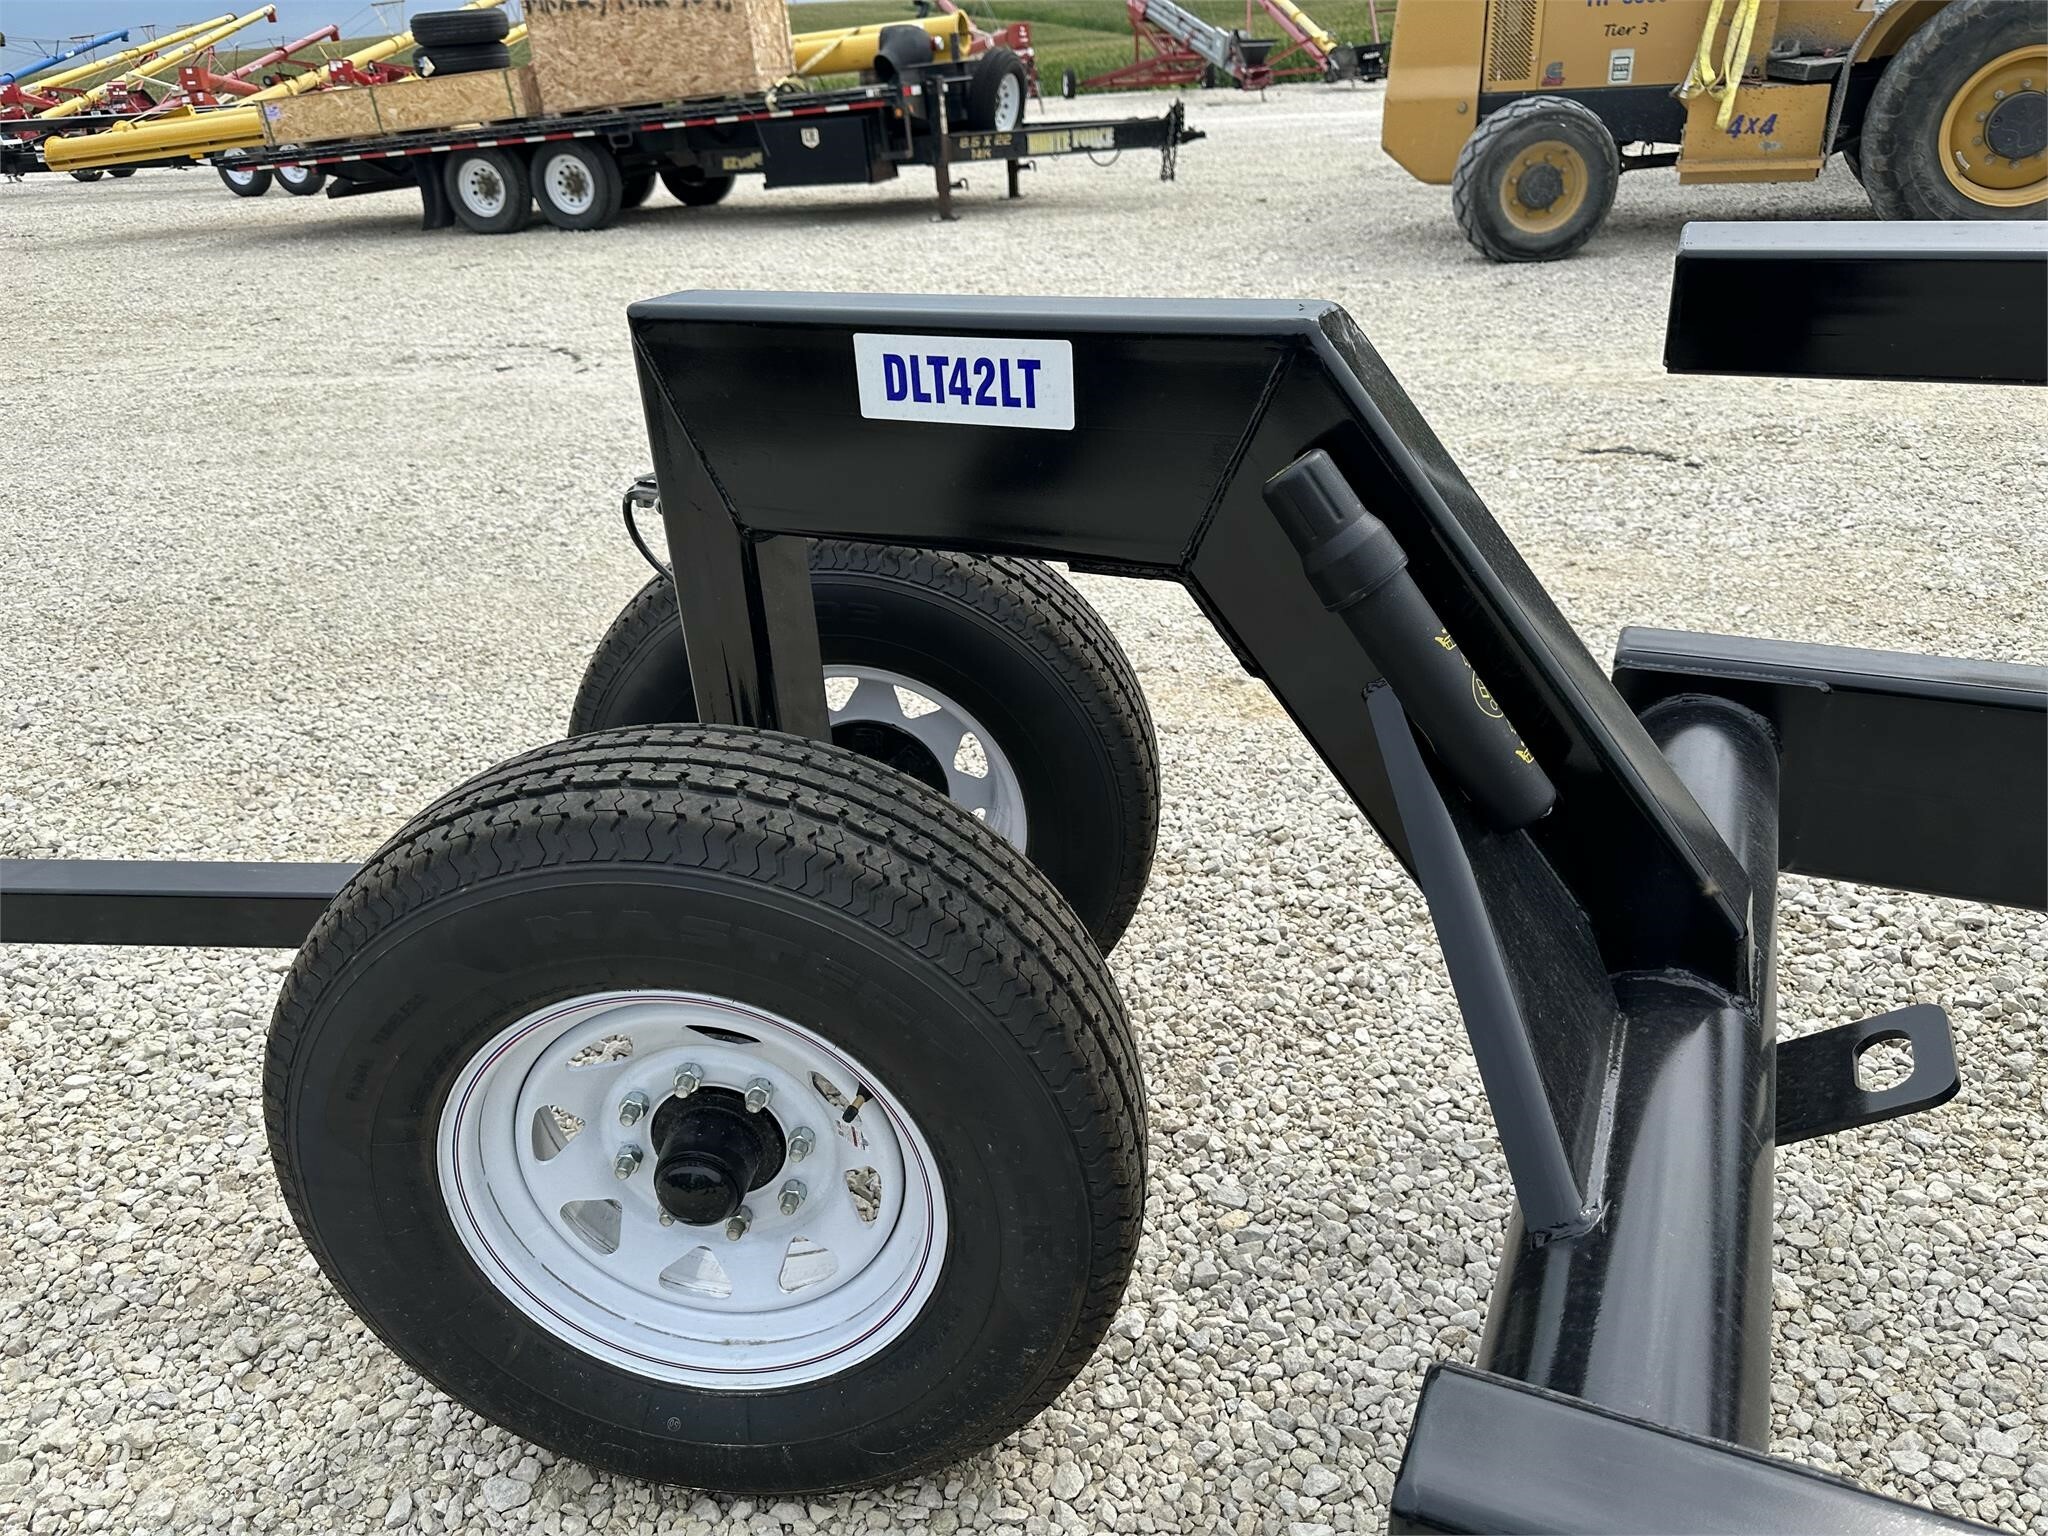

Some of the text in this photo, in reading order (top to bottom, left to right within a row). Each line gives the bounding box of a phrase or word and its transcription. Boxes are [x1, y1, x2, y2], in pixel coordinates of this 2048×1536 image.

[1603, 20, 1650, 38] Tier 3
[882, 353, 1042, 409] DLT42LT
